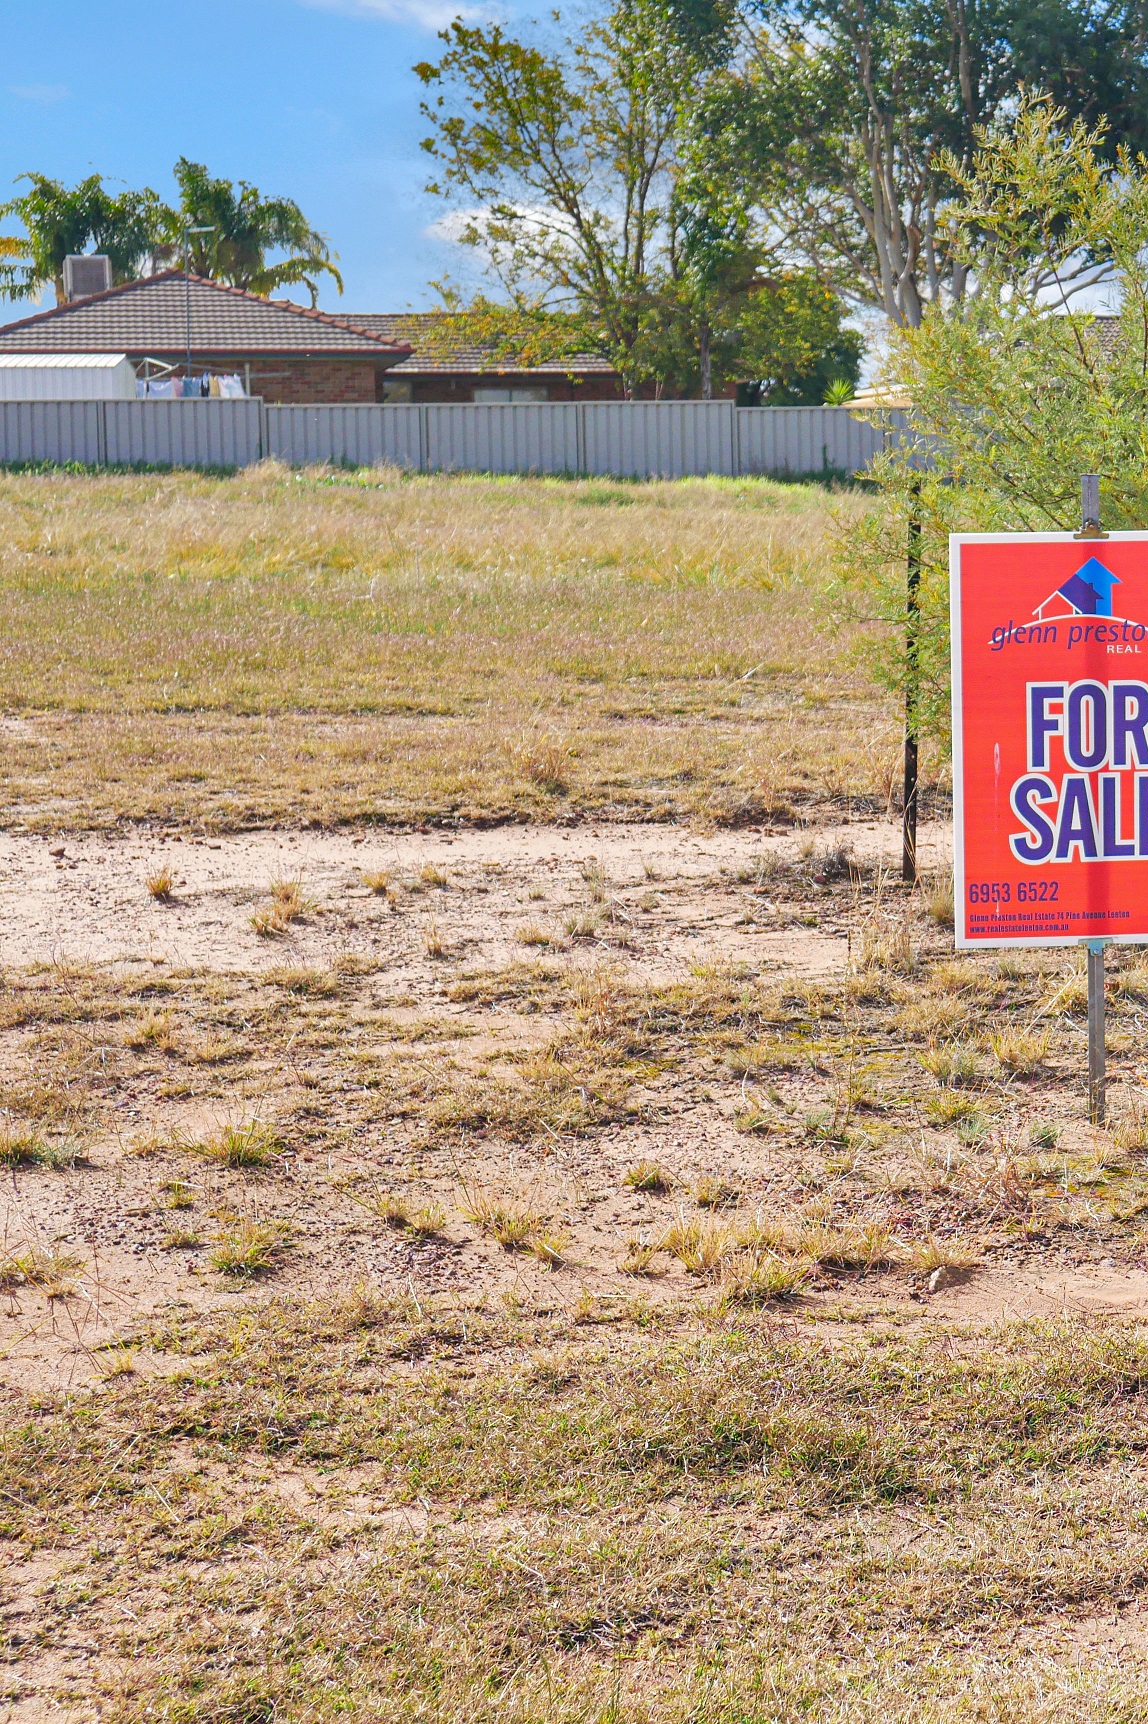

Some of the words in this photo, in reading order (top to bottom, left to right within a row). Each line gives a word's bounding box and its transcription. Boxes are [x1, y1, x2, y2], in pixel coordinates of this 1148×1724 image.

[990, 620, 1057, 651] glenn
[1106, 644, 1142, 653] REAL
[969, 882, 1011, 903] 6953
[1017, 881, 1059, 902] 6522
[1018, 913, 1033, 921] Real
[1034, 912, 1055, 921] Estate
[1107, 910, 1130, 919] Leeton
